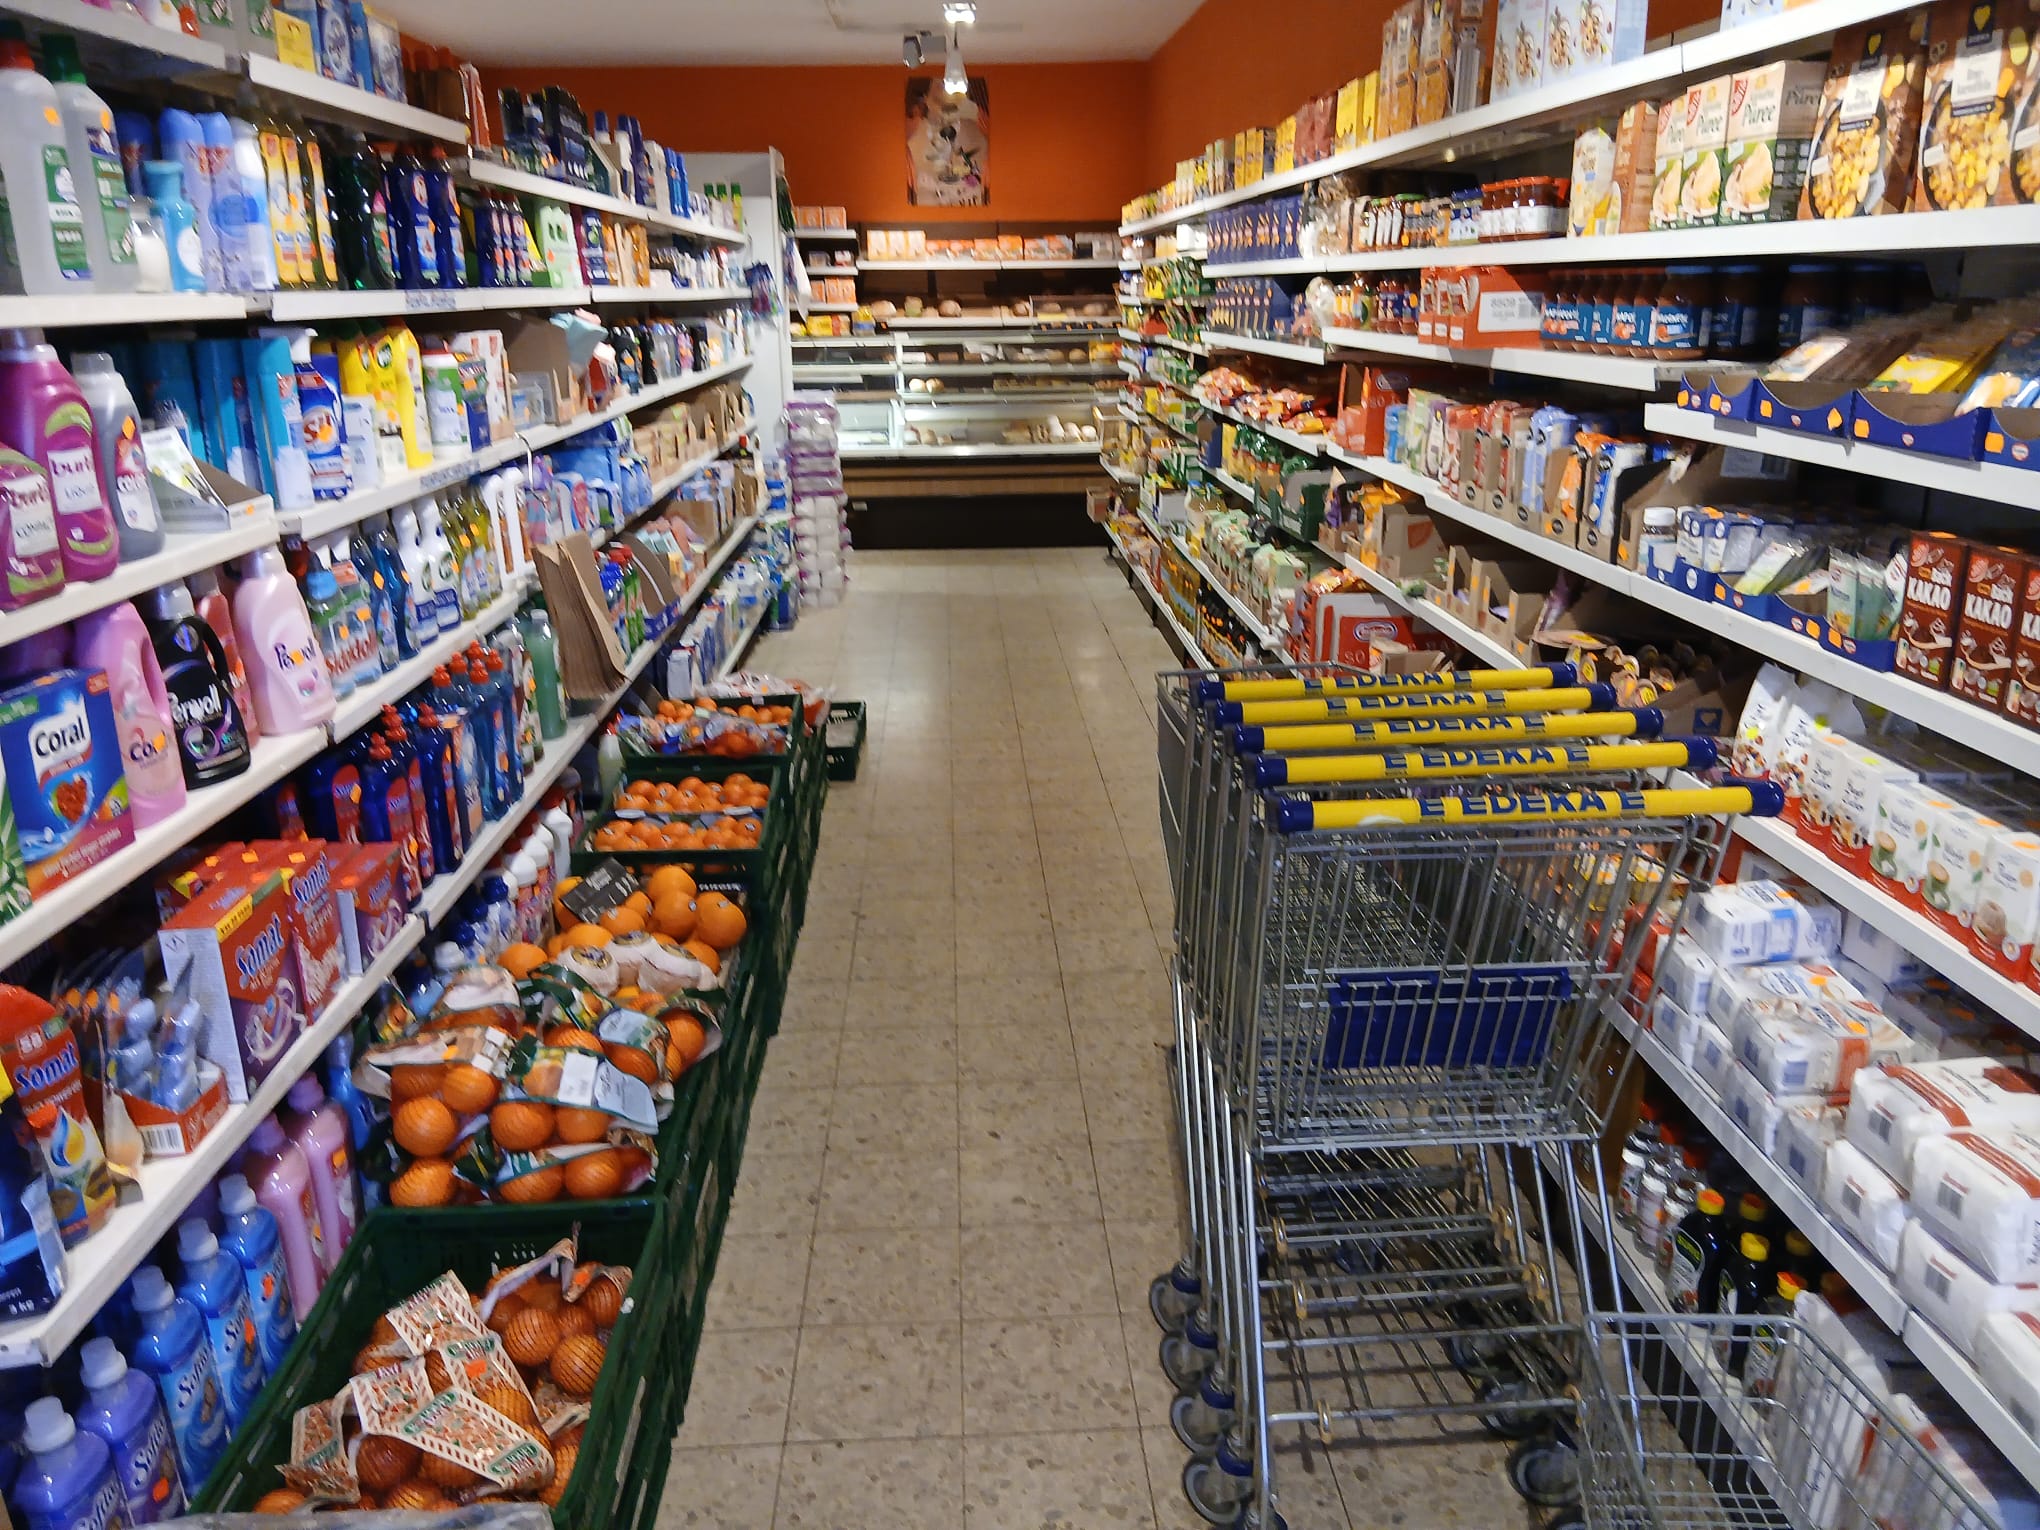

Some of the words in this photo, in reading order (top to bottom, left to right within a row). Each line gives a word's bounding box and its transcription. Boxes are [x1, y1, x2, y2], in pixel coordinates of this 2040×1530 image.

[1907, 576, 1951, 611] KAKAO
[1964, 592, 2012, 630] KAKAO
[1336, 673, 1443, 689] EDEKA
[1360, 691, 1475, 709] EDEKA
[35, 716, 87, 758] Coral
[1388, 716, 1512, 733] EDEKA
[1421, 746, 1555, 768] EDEKA
[1461, 791, 1606, 815] EDEKA
[236, 912, 286, 982] Somat
[14, 1043, 79, 1097] Somat
